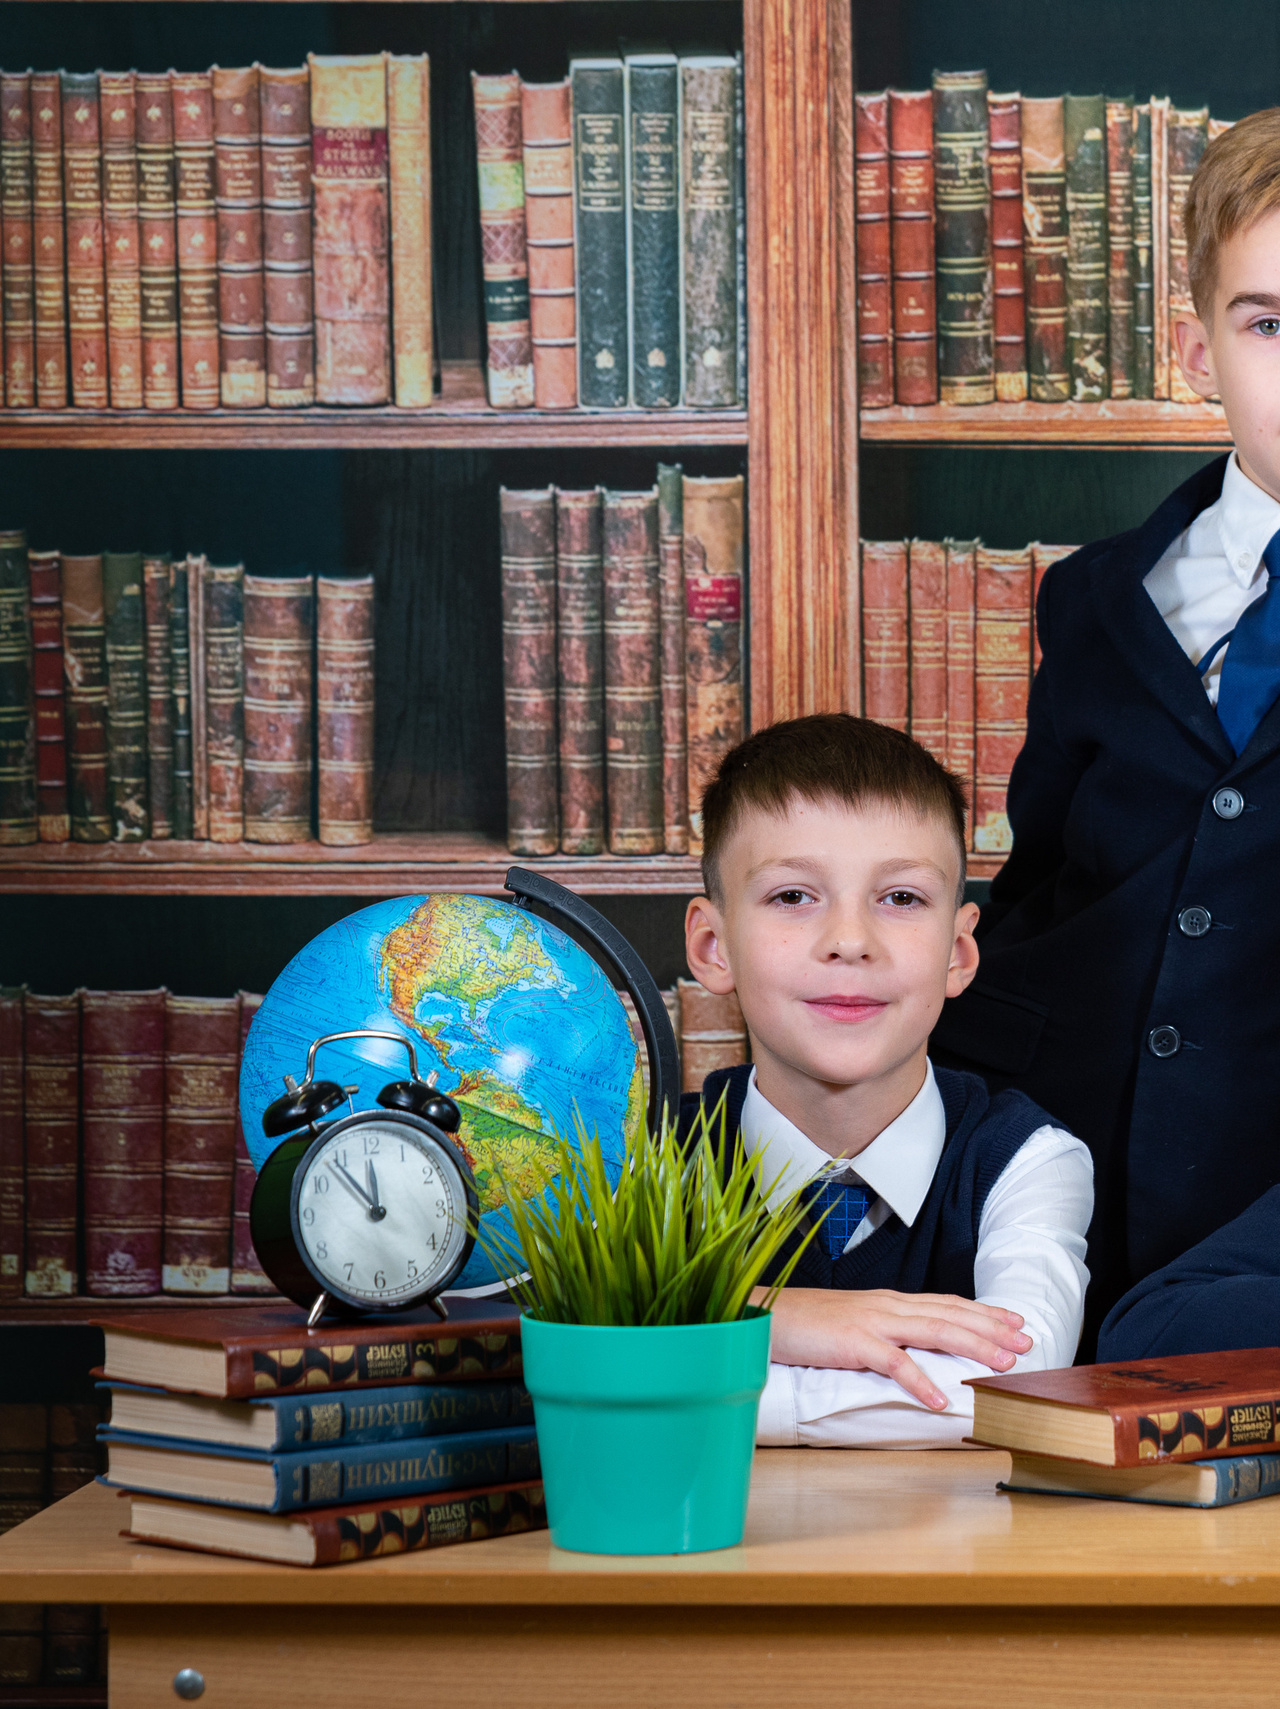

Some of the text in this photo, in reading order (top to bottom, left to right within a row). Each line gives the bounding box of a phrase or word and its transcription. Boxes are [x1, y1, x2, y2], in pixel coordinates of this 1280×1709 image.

[363, 1136, 380, 1155] 12
[335, 1149, 348, 1168] 11
[422, 1165, 434, 1184] 2
[313, 1175, 330, 1194] 10
[303, 1207, 315, 1226] 9
[435, 1199, 447, 1218] 3
[316, 1241, 328, 1259] 8
[426, 1233, 438, 1250] 4
[342, 1263, 354, 1282] 7
[407, 1260, 418, 1279] 5
[374, 1271, 386, 1289] 6
[415, 1342, 435, 1357] 3
[1230, 1405, 1271, 1425] КУПЕР
